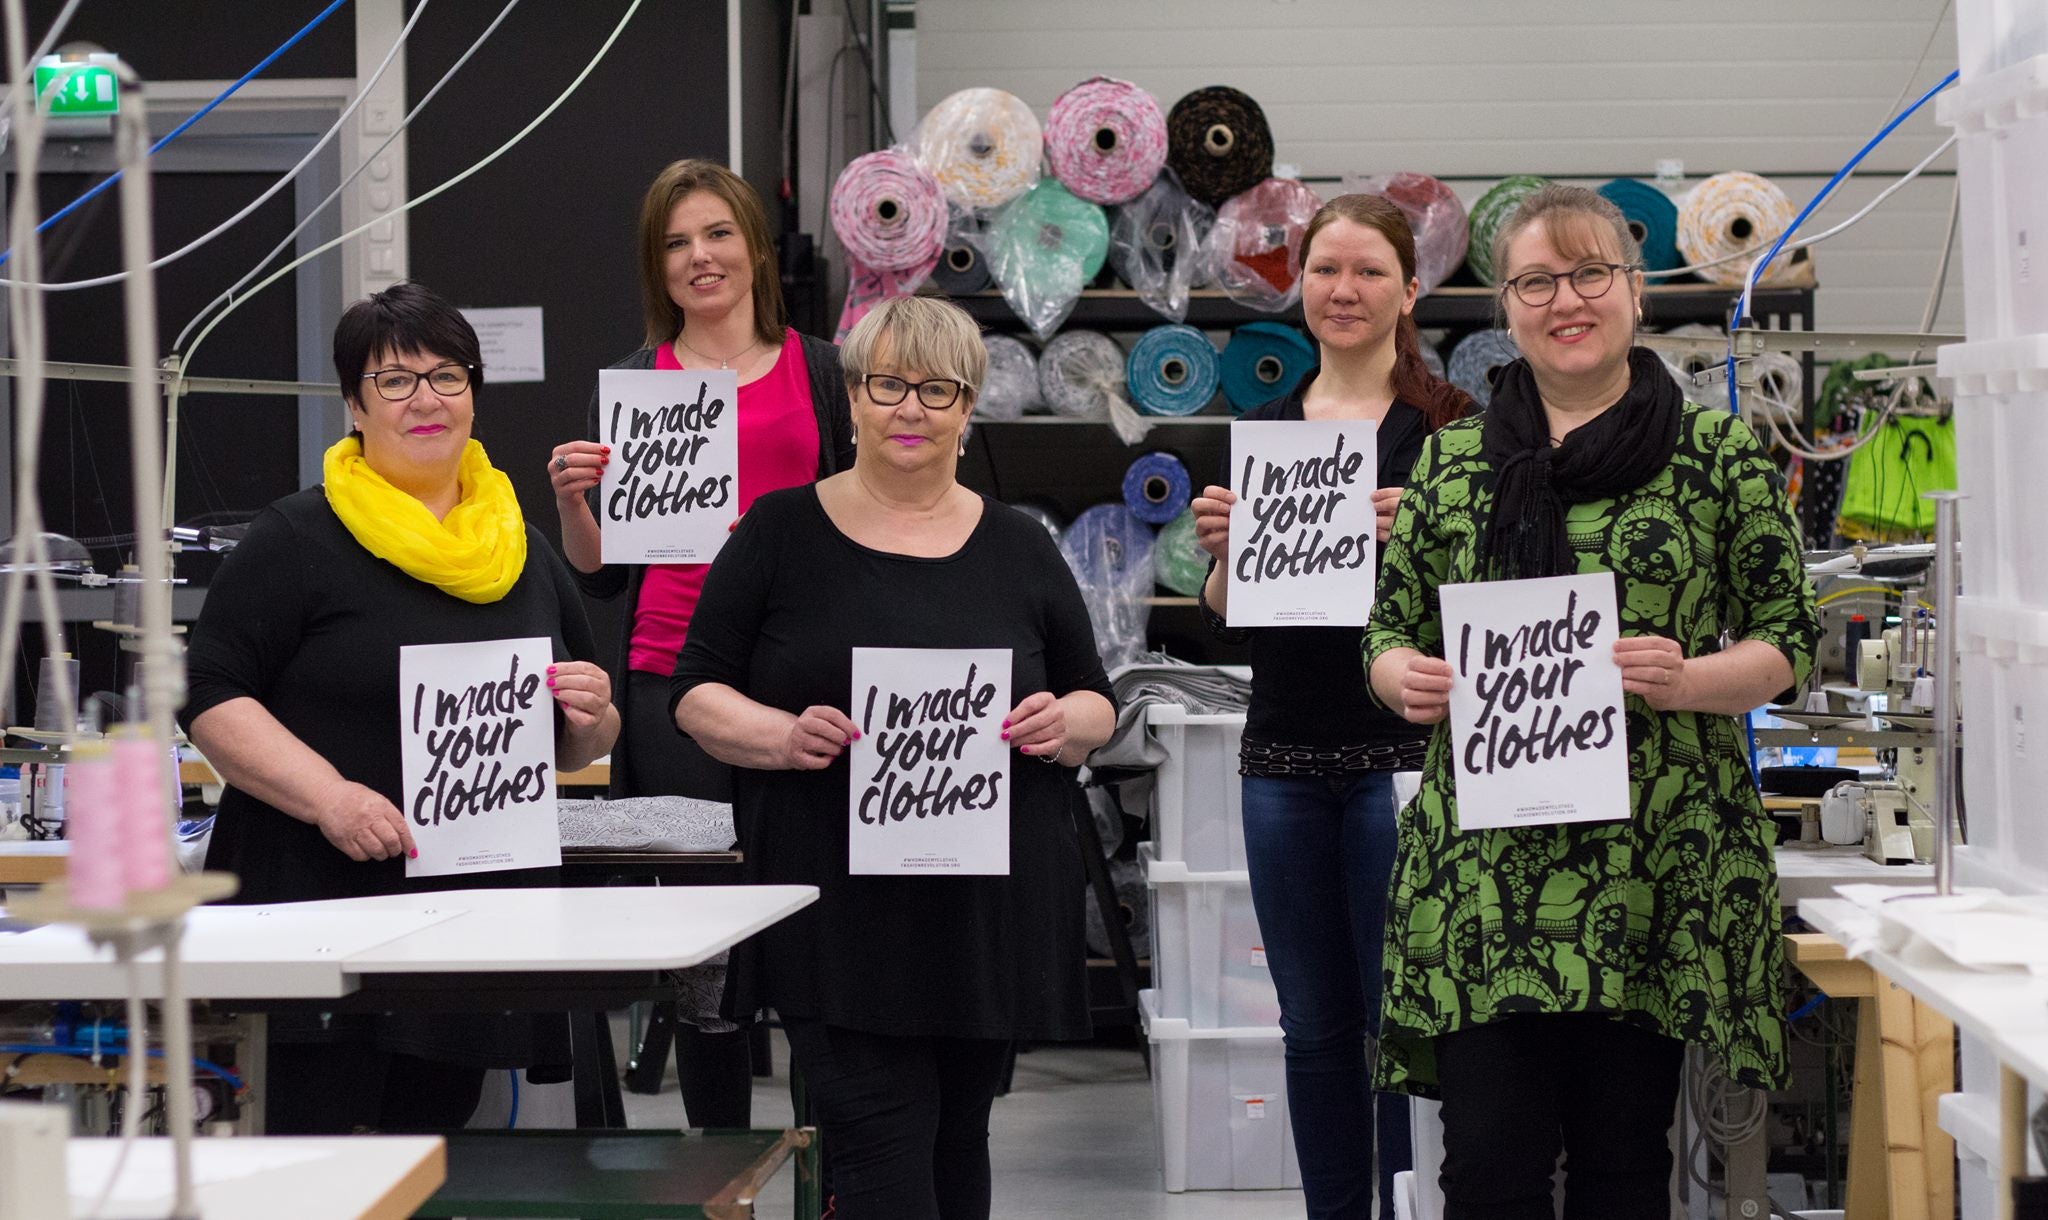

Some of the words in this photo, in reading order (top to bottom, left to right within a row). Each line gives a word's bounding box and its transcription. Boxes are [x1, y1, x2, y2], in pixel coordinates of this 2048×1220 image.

[611, 401, 623, 445] I
[630, 381, 725, 439] made
[619, 434, 710, 486] your
[1241, 455, 1255, 501] I
[1262, 432, 1364, 497] made
[608, 470, 733, 523] clothes
[1248, 490, 1347, 545] your
[1236, 529, 1370, 583] clothes
[1459, 623, 1472, 678] I
[1484, 590, 1601, 670] made
[413, 683, 426, 735] I
[434, 653, 540, 727] made
[863, 685, 878, 735] I
[886, 662, 996, 730] made
[1475, 657, 1585, 729] your
[424, 717, 524, 783] your
[871, 724, 979, 783] your
[1464, 705, 1617, 775] clothes
[413, 761, 549, 827] clothes
[858, 766, 1003, 826] clothes
